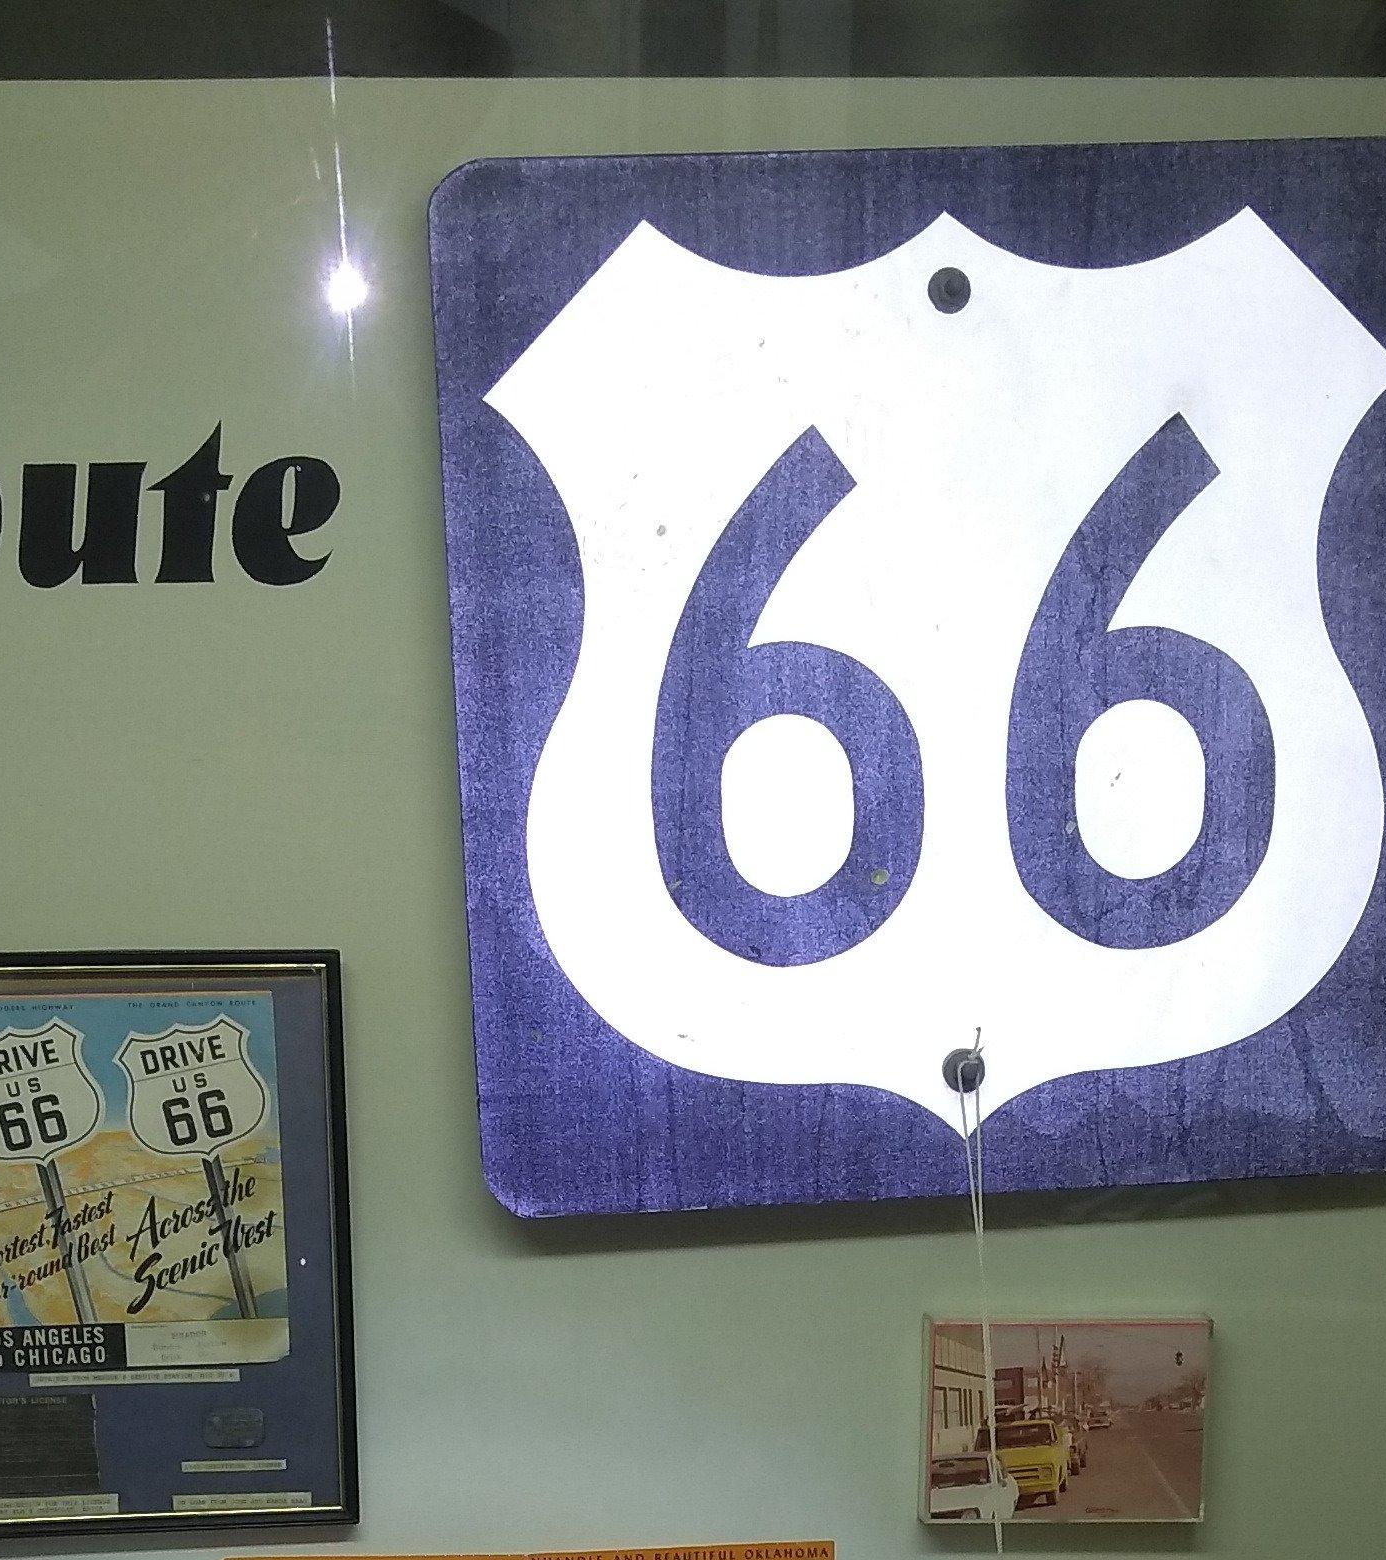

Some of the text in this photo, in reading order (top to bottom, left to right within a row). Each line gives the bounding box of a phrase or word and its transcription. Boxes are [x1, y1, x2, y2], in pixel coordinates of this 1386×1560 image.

[651, 411, 1275, 967] 66
[140, 1035, 226, 1075] DRIVE
[163, 1089, 233, 1147] 66
[126, 1196, 219, 1262] Across
[223, 1168, 256, 1208] the
[79, 1223, 116, 1264] Best
[126, 1210, 278, 1315] Scenic West
[15, 1346, 107, 1367] CHICAGO
[23, 1326, 106, 1347] ANGELES
[744, 1547, 830, 1560] OKLAHOMA
